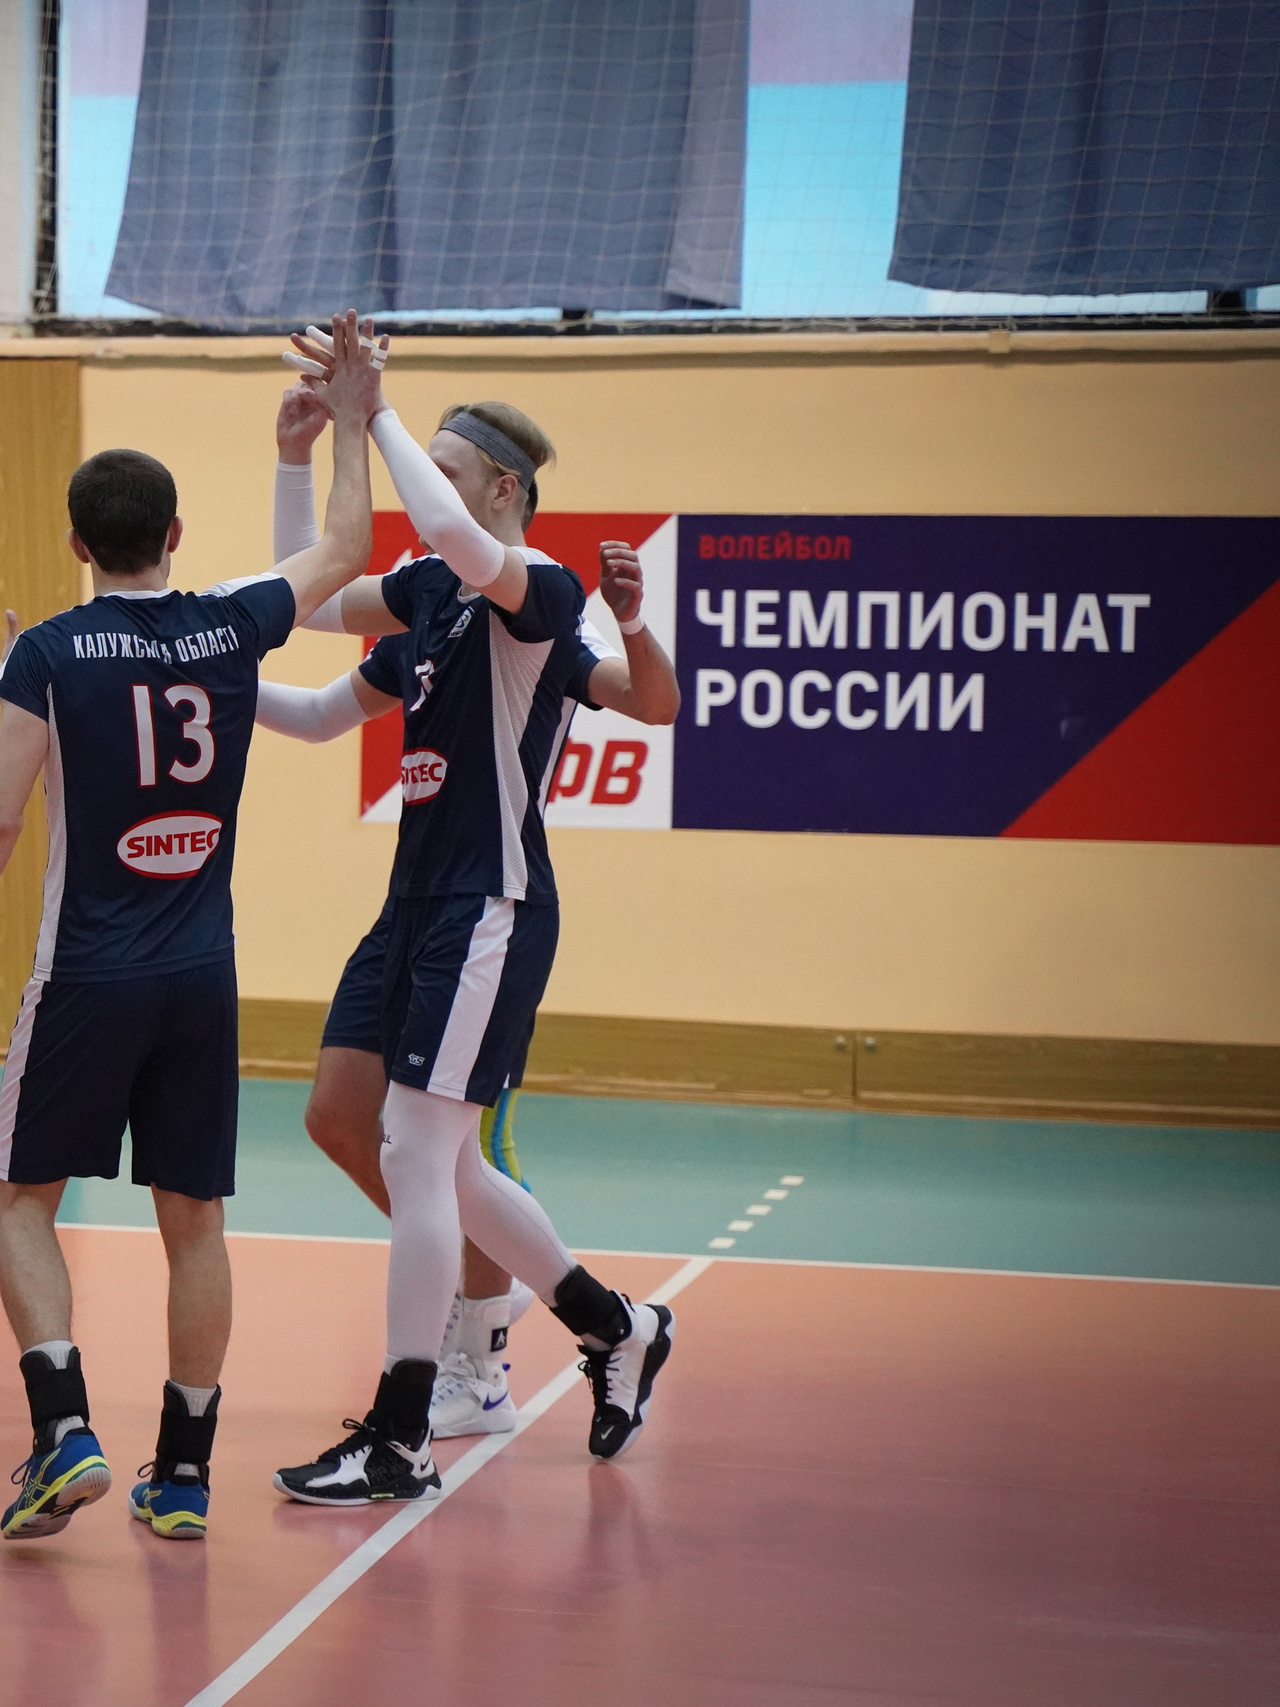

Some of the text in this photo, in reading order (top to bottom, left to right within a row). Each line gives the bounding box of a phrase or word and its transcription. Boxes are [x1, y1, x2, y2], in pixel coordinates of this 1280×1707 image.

[698, 531, 851, 561] ВОЛЕЙБОЛ
[694, 588, 1151, 654] ЧЕМПИОНАТ
[695, 669, 986, 732] РОССИИ
[131, 683, 217, 788] 13
[127, 827, 220, 859] SINTEC
